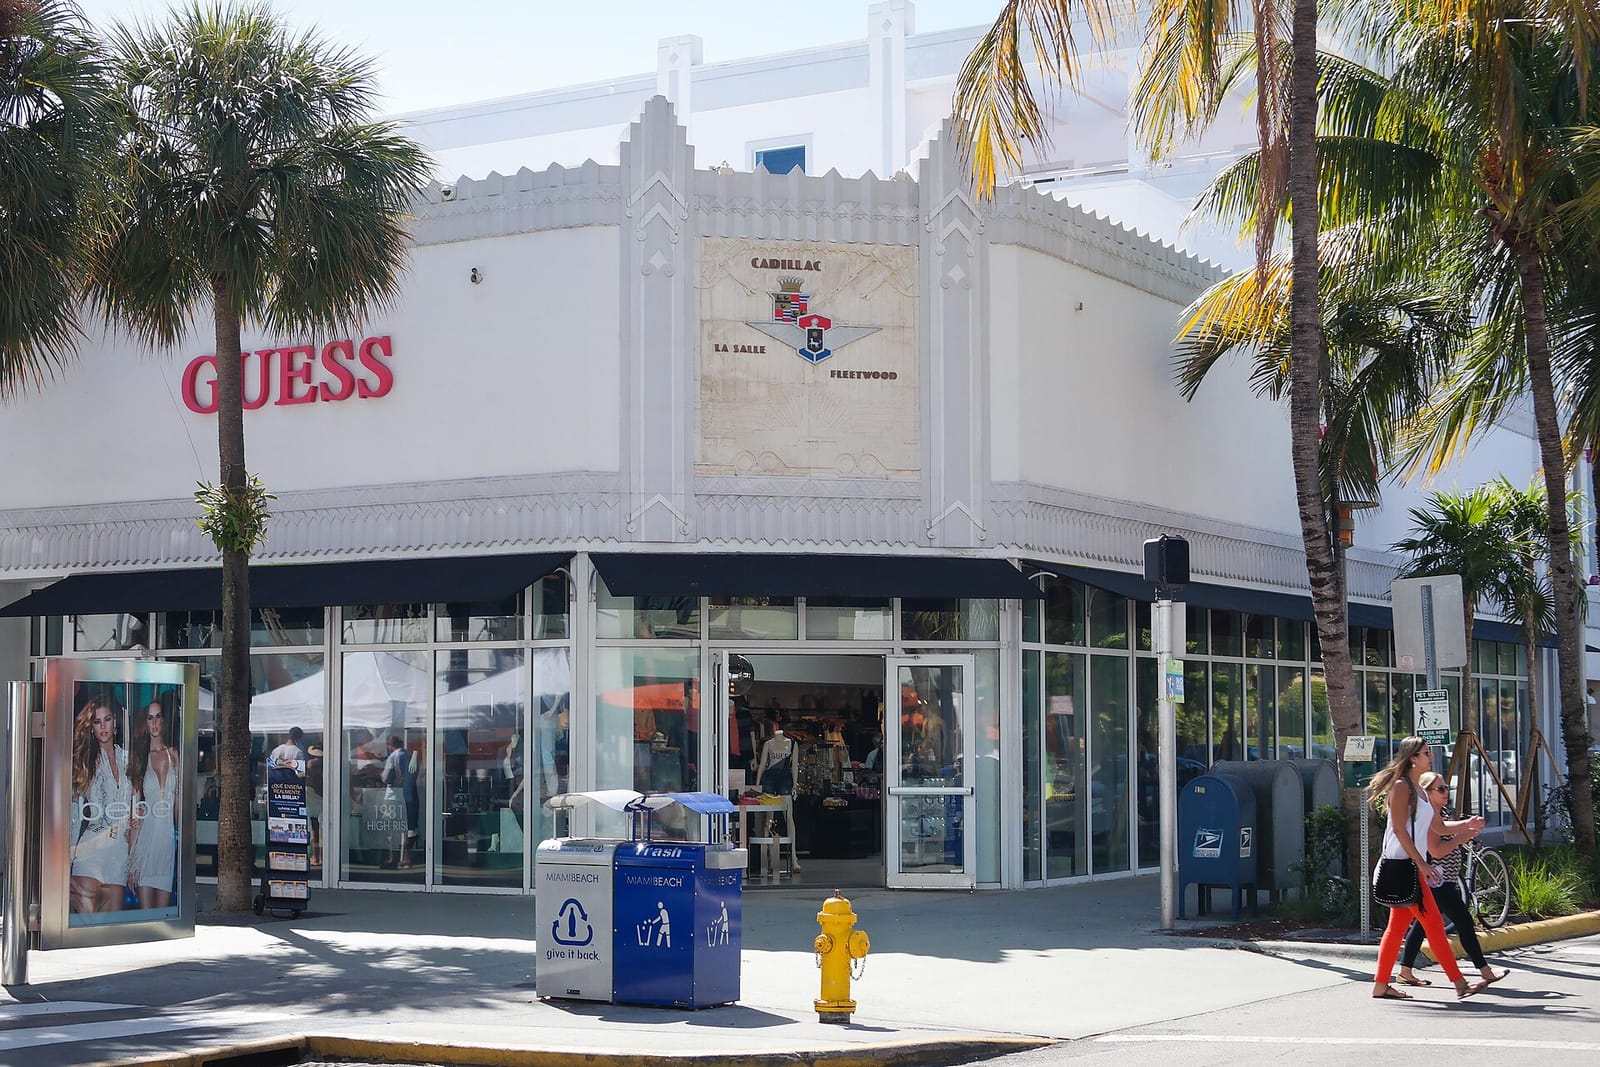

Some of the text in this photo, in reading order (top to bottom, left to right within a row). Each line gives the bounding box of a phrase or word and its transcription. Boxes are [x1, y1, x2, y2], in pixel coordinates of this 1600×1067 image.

[751, 257, 821, 271] CADILLAC
[715, 344, 766, 353] LA SALLE
[181, 335, 393, 414] GUESS
[830, 369, 898, 380] FLEETWOOD
[78, 795, 171, 820] bebe
[373, 804, 403, 819] 1981
[367, 820, 390, 831] HIGH
[546, 948, 565, 960] give
[568, 948, 575, 959] it
